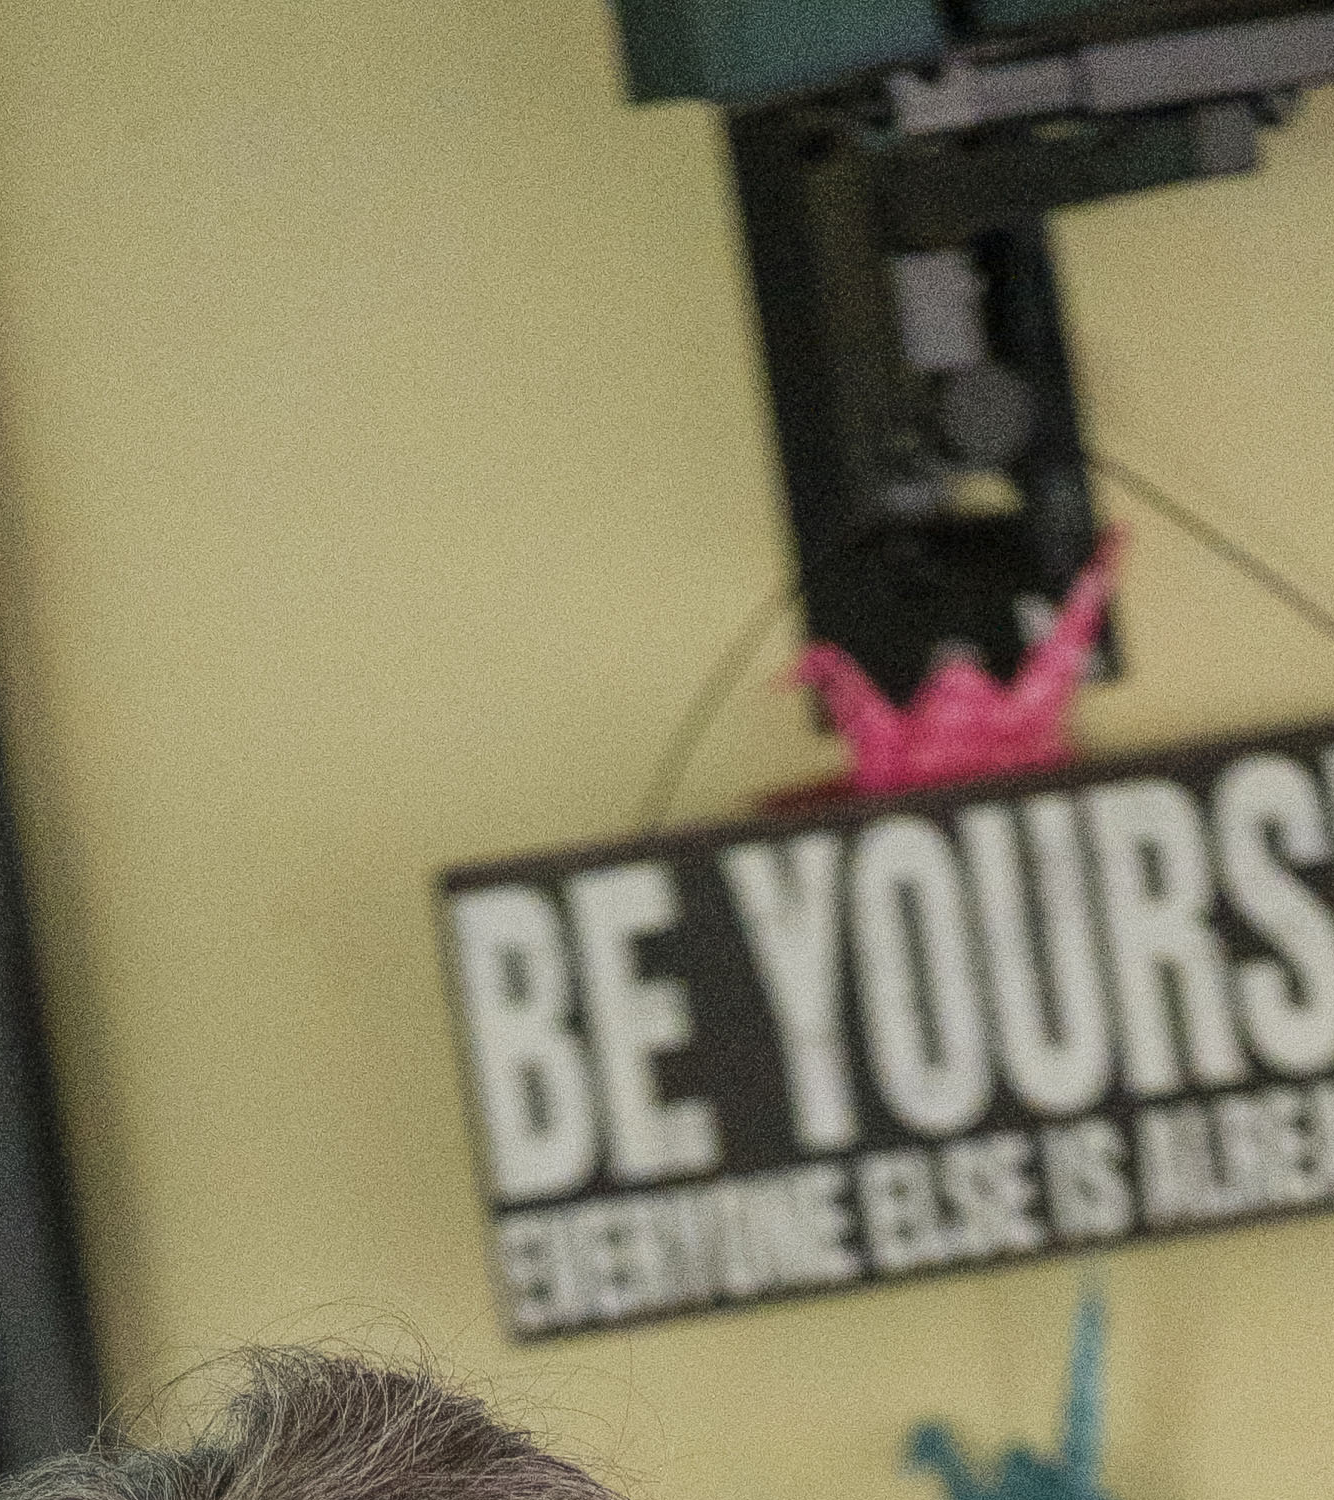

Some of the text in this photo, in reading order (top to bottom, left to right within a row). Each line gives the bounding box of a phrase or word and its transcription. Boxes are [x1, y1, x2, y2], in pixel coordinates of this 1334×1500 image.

[447, 860, 721, 1202] BE
[495, 1162, 863, 1330] EVERYONE
[866, 1123, 1049, 1275] ELSE
[1043, 1115, 1132, 1243] IS
